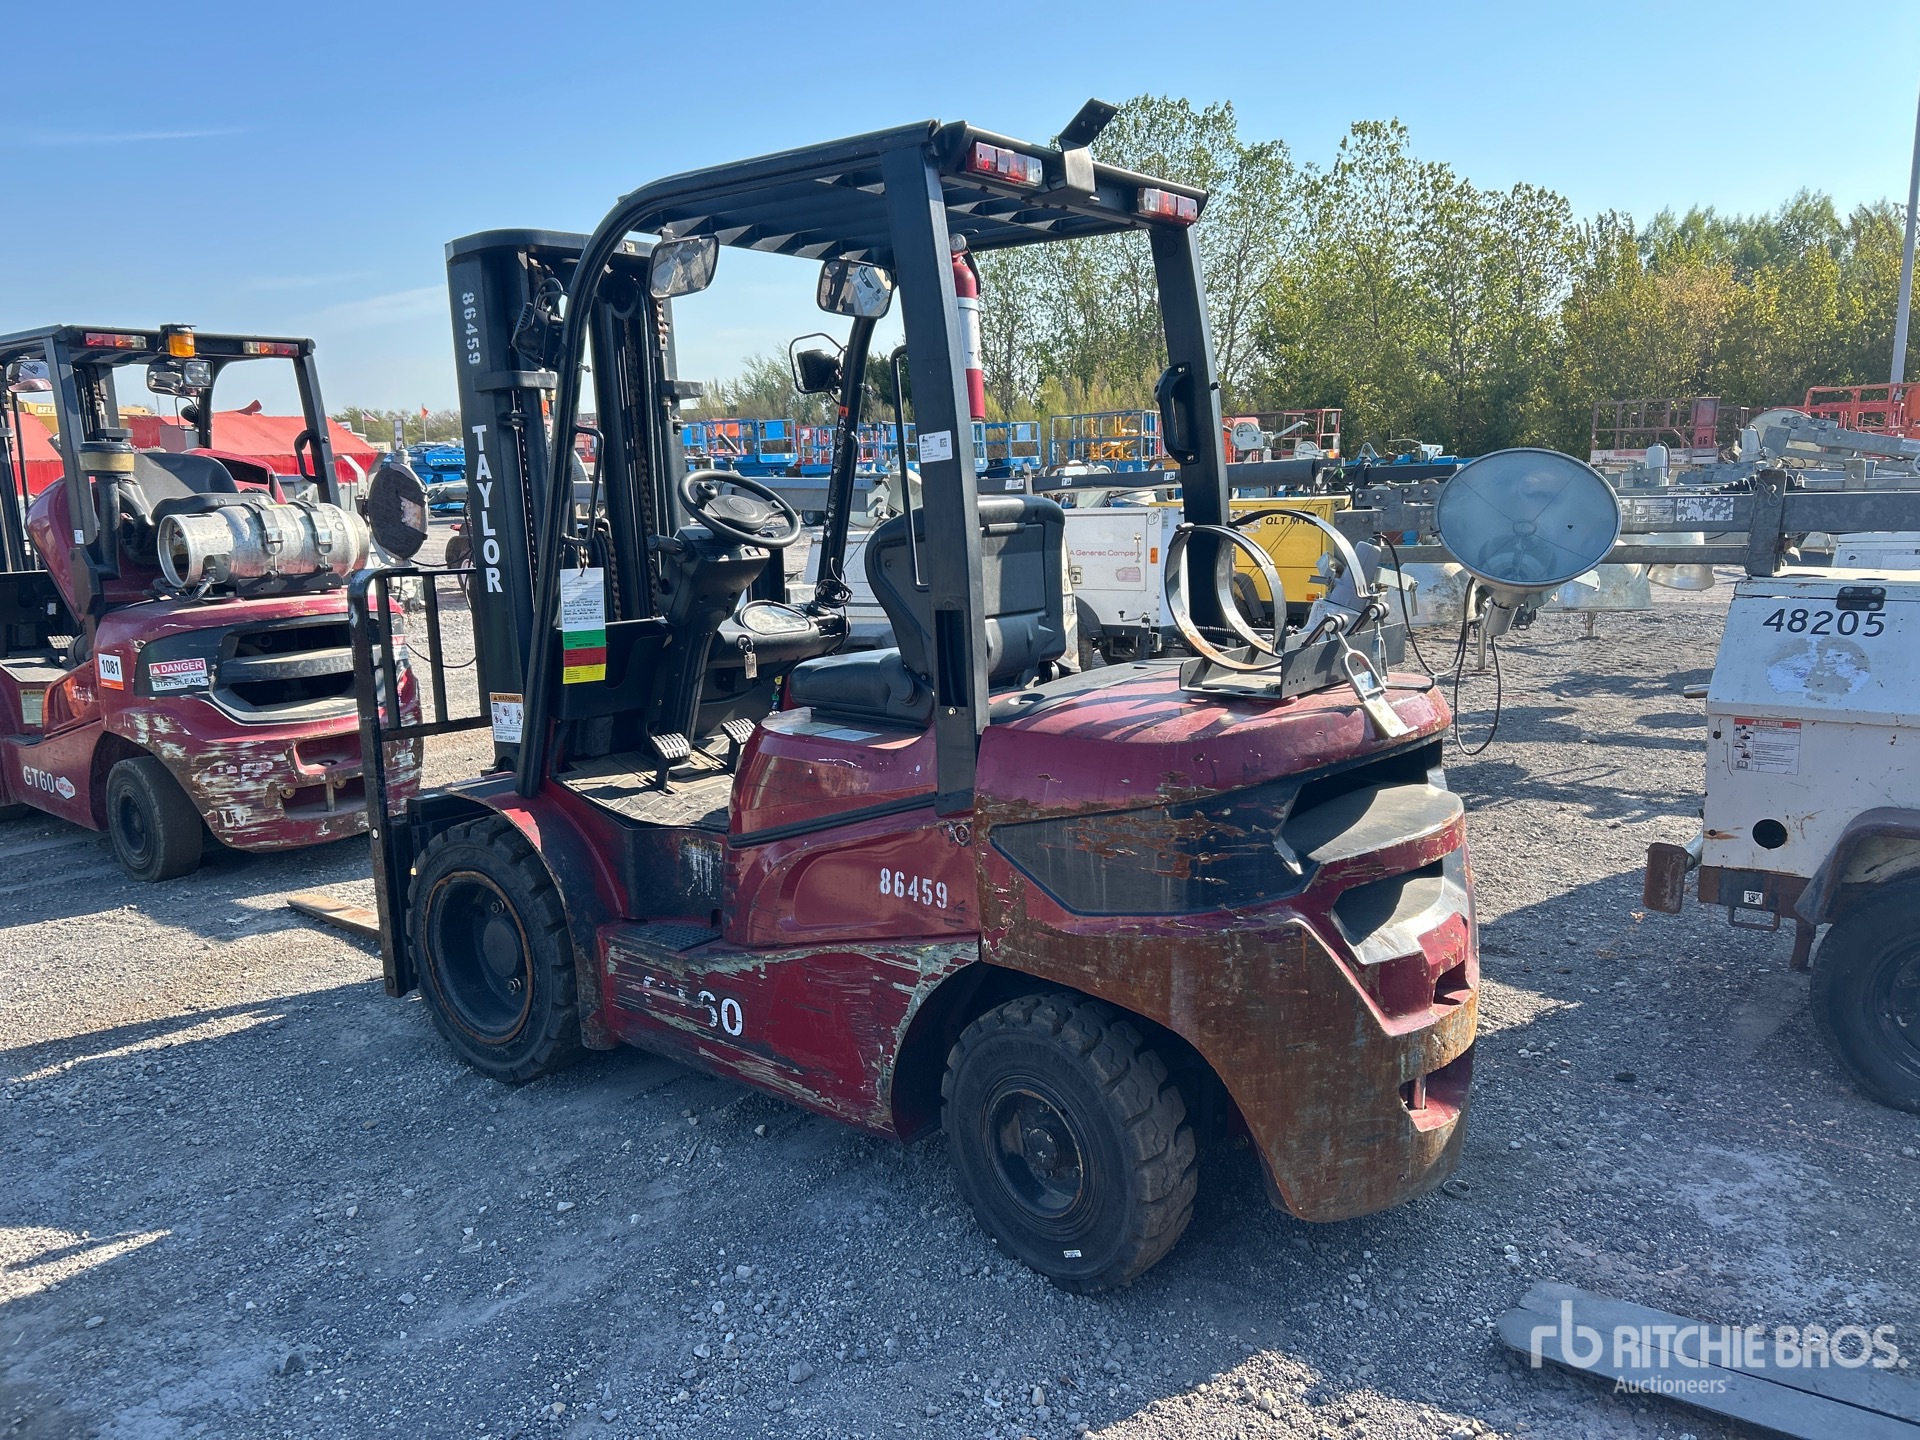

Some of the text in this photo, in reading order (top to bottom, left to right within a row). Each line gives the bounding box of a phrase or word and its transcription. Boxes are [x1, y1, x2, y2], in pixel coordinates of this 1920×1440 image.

[462, 291, 482, 365] 86459
[471, 424, 503, 593] TAYLOR
[1265, 517, 1287, 525] QLT
[1108, 549, 1143, 557] Company
[1762, 608, 1887, 638] 48205
[101, 659, 120, 675] 1081
[160, 661, 204, 674] DANGER
[1758, 720, 1784, 728] DANGER
[22, 765, 56, 794] GT60
[879, 867, 949, 909] 86459
